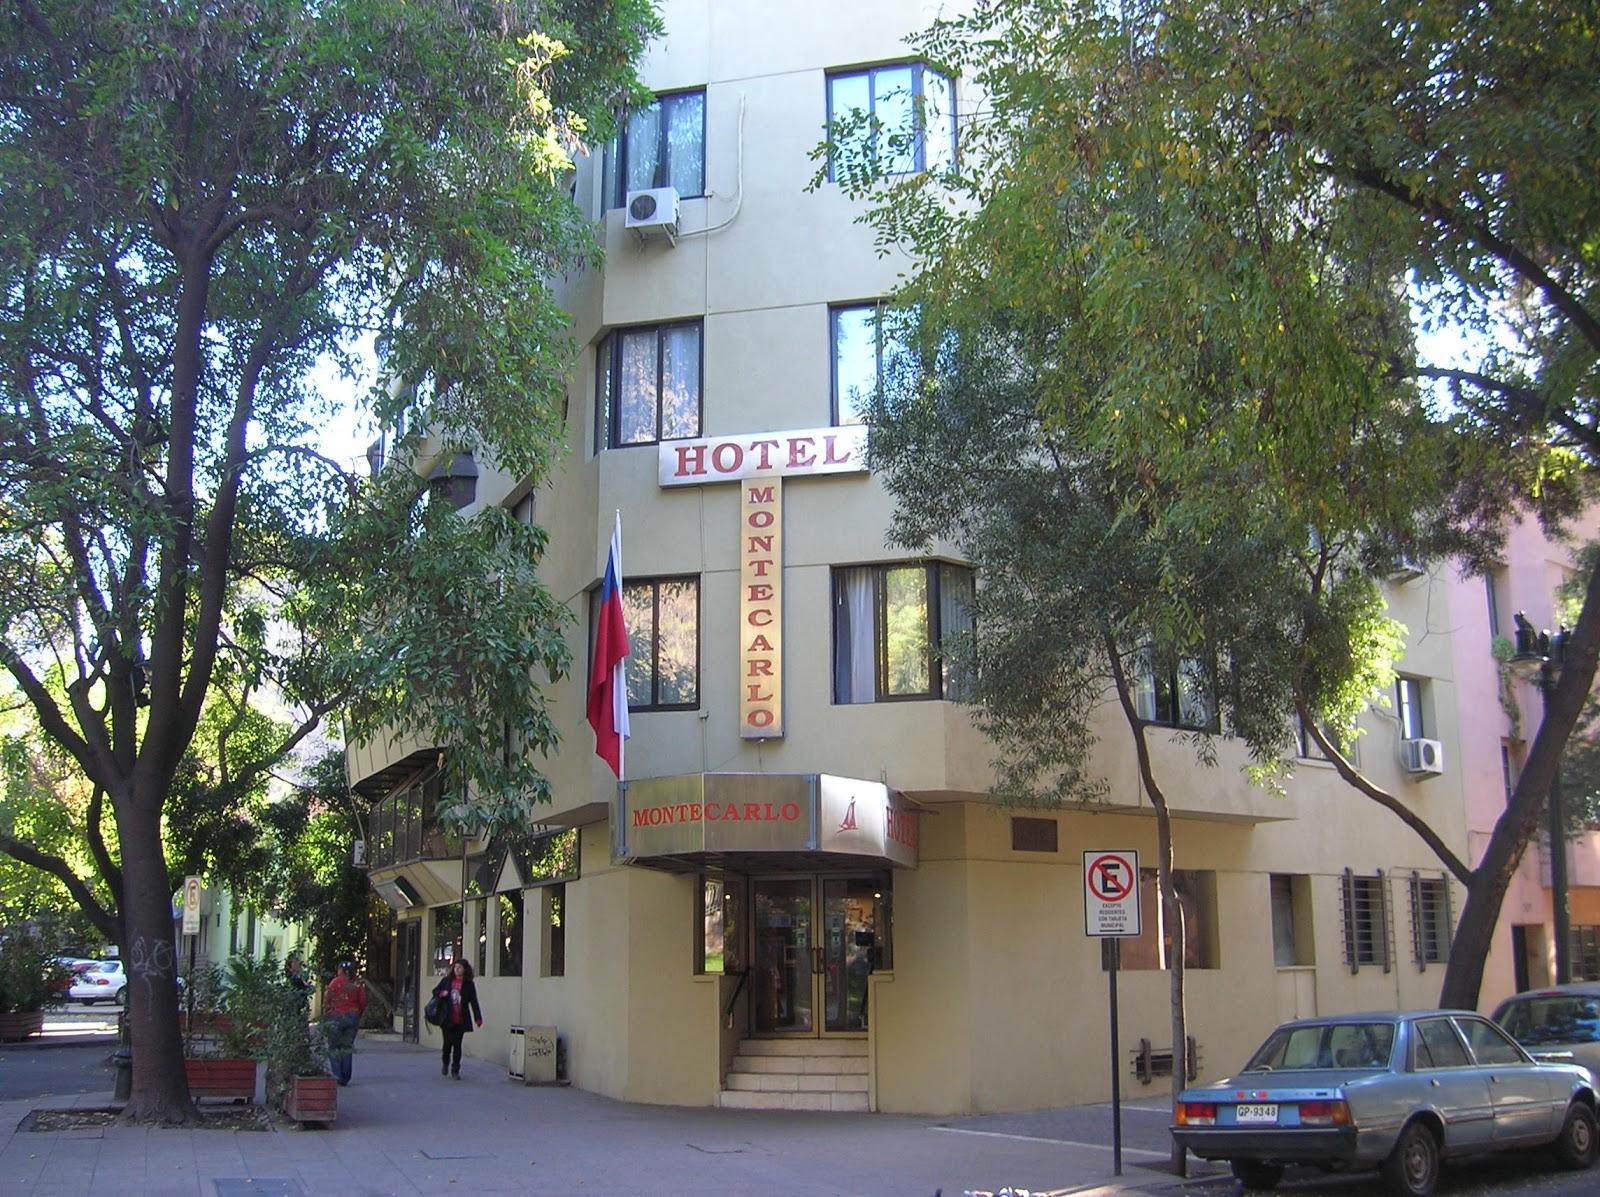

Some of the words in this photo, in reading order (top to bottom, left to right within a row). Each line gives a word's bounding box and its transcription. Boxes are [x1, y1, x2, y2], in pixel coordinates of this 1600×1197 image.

[674, 435, 851, 477] HOTEL
[747, 486, 775, 728] MONTECARLO
[633, 802, 801, 827] MONTECARLO
